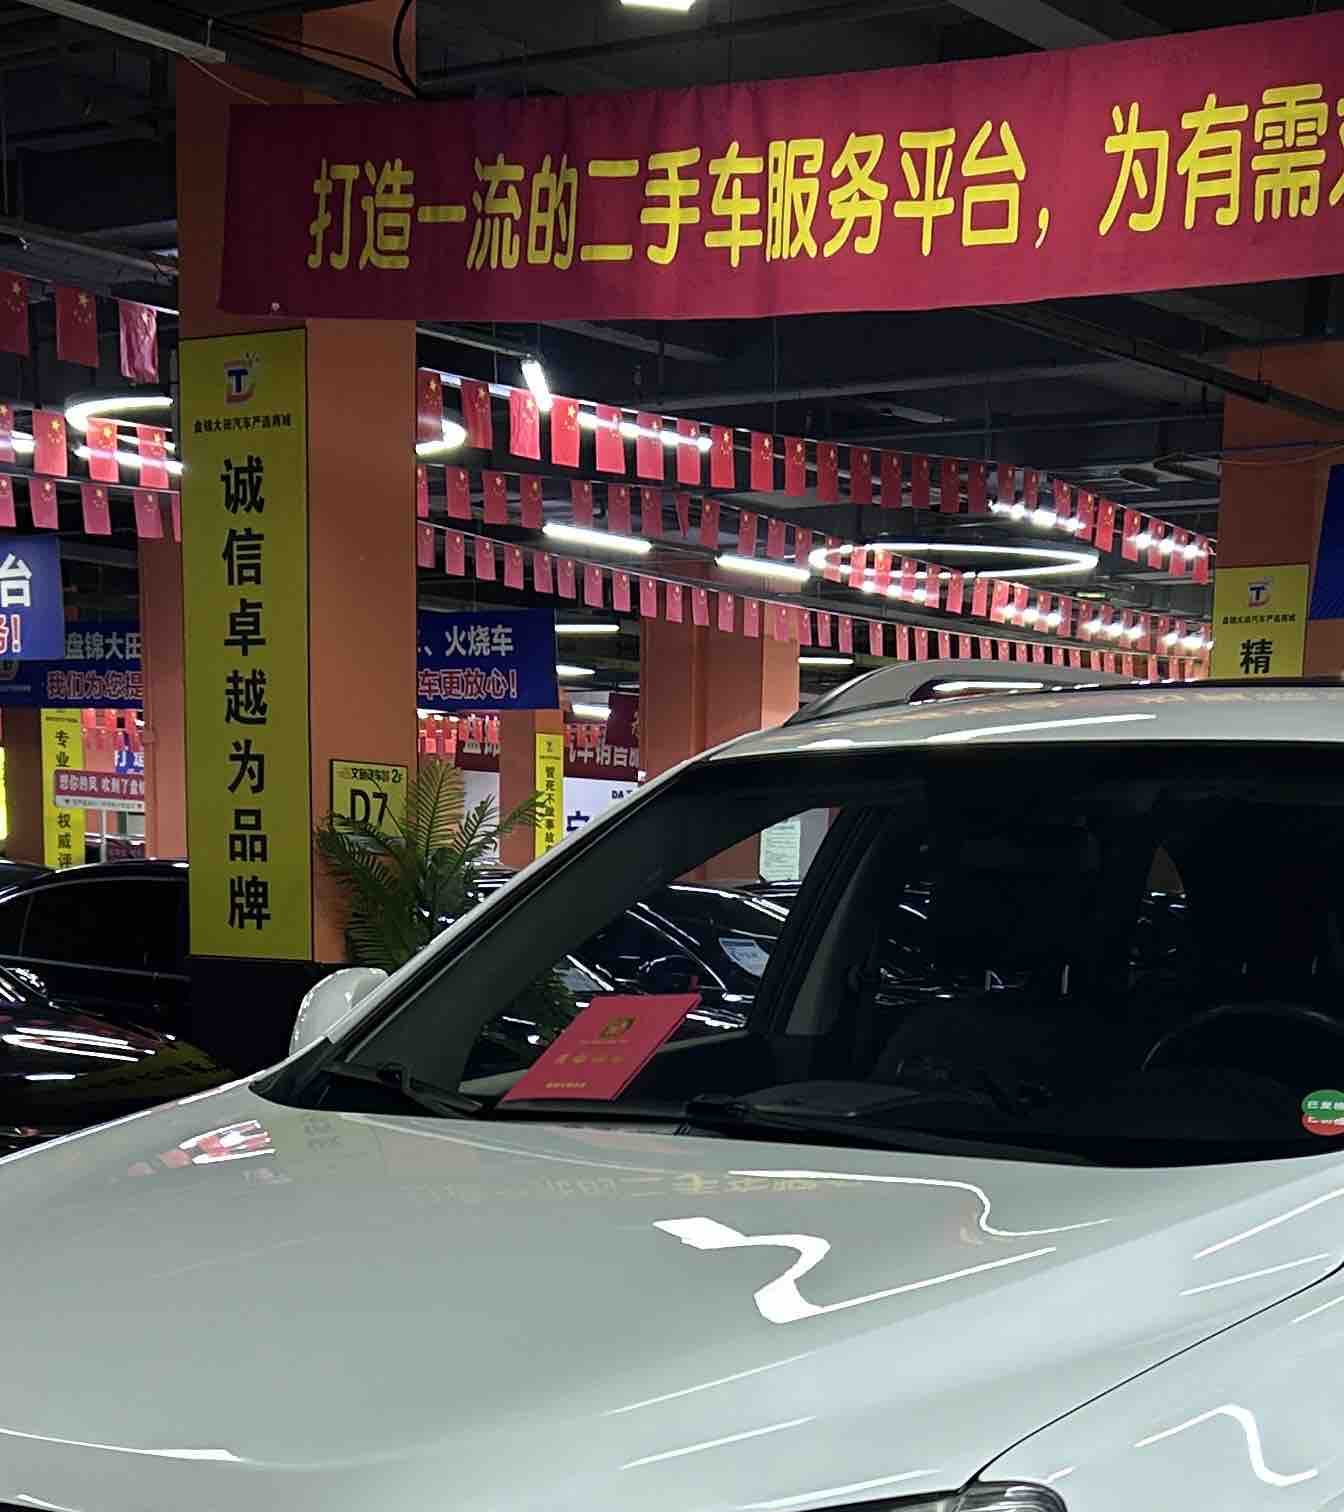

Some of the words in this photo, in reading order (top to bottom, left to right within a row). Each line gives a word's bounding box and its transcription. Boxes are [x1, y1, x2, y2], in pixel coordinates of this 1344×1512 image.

[1239, 638, 1273, 674] 精
[221, 455, 271, 930] 诚信卓越为品牌
[350, 788, 388, 827] D7
